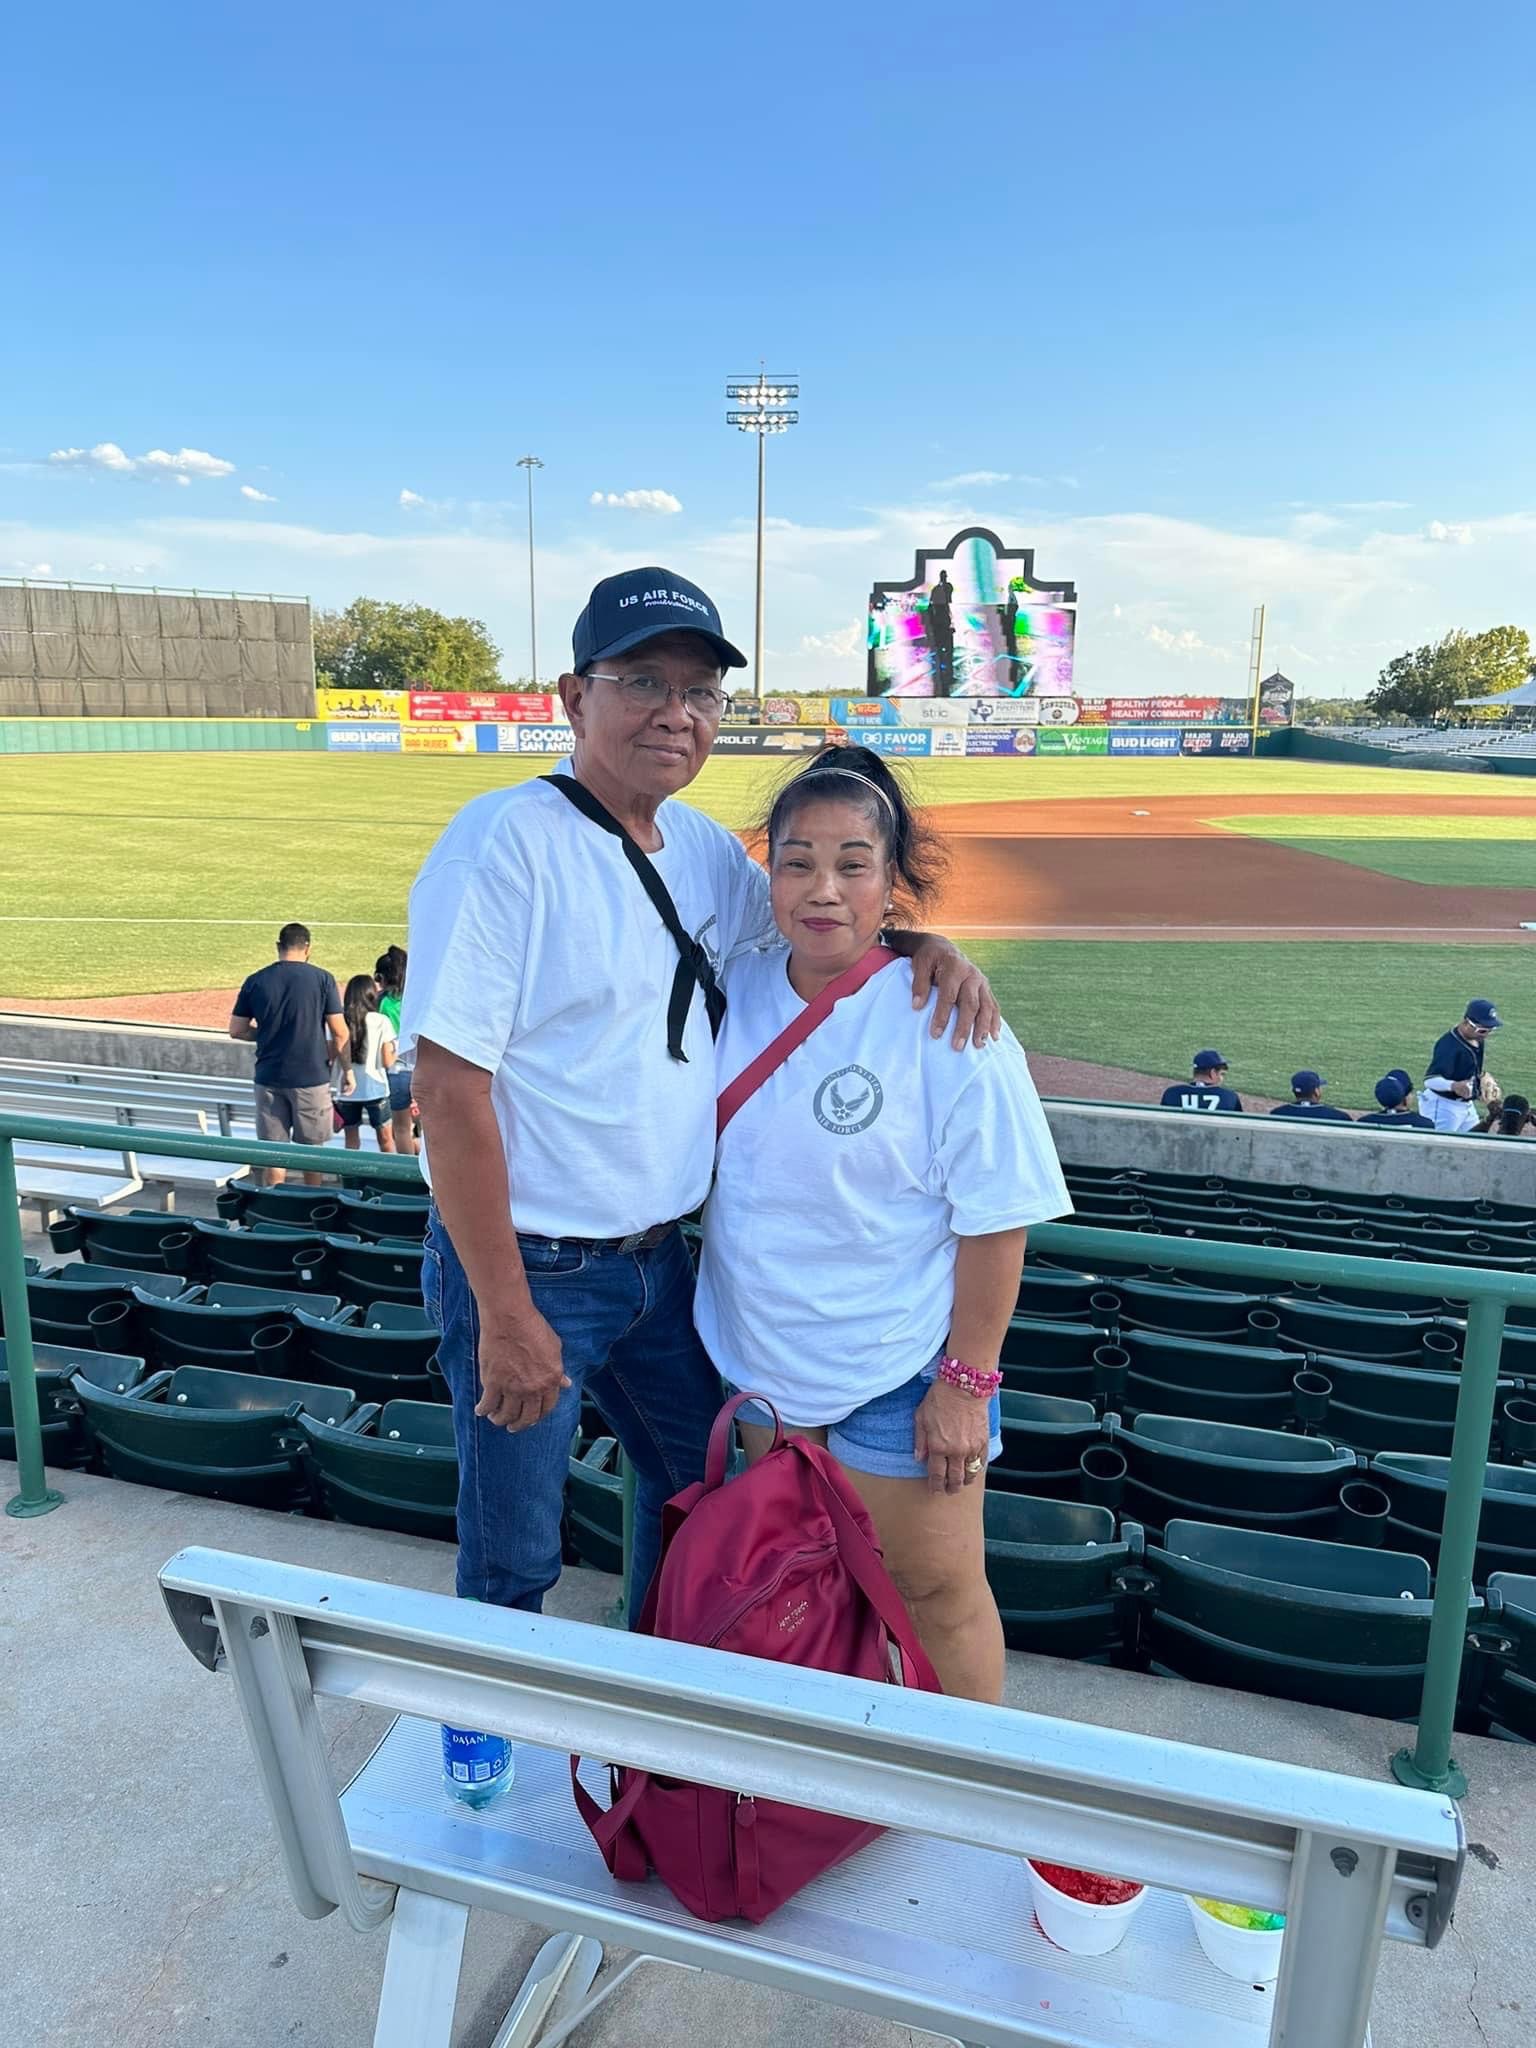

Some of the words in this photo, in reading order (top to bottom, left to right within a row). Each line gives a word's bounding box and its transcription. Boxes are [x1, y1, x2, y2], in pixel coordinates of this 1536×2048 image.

[620, 595, 639, 608] US
[643, 589, 668, 601] AIR
[672, 591, 709, 616] FORCE
[1111, 700, 1149, 708] HEALTHY
[1151, 700, 1186, 708] PEOPLE.
[1111, 709, 1148, 717] HEALTHY
[1150, 709, 1201, 718] COMMUNITY.
[331, 731, 361, 742] BUD
[362, 731, 400, 743] LIGHT
[519, 729, 576, 742] GOODW
[713, 735, 758, 744] VROLET
[884, 733, 927, 744] FAVOR
[520, 742, 544, 752] SAN
[545, 742, 576, 752] ANTO
[1111, 737, 1138, 748] BUD
[1140, 737, 1177, 748] LIGHT
[832, 1123, 865, 1133] FORCE
[452, 1733, 488, 1747] DASANI
